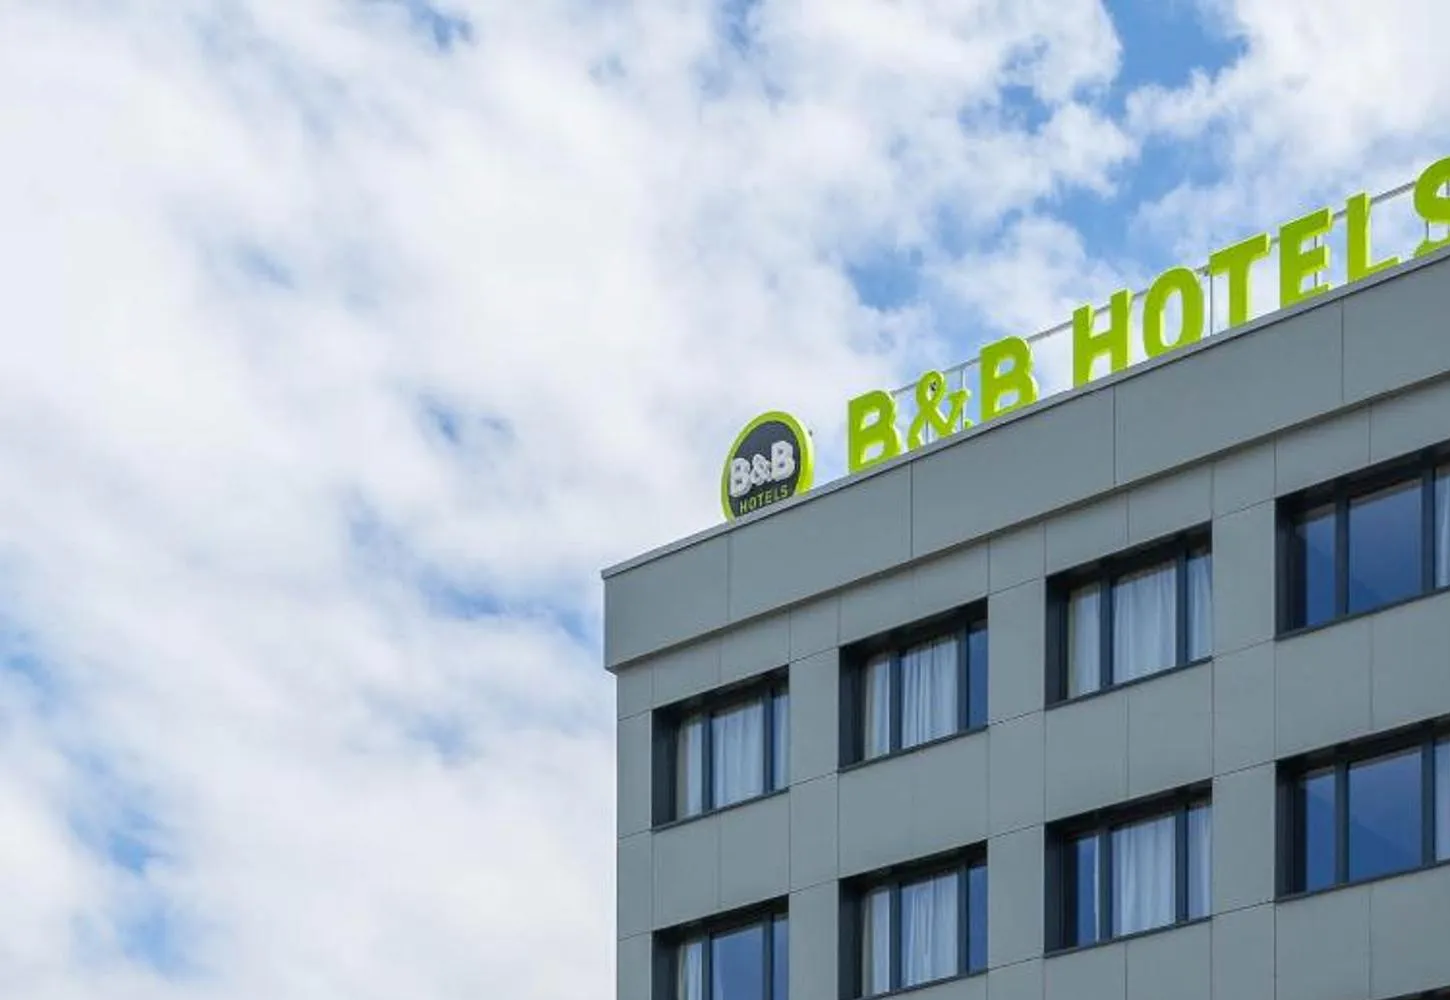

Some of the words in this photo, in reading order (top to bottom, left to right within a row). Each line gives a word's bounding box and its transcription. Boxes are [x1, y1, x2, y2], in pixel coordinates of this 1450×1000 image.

[848, 335, 1039, 474] B&B
[730, 440, 795, 498] B&B
[740, 485, 788, 513] HOTELS
